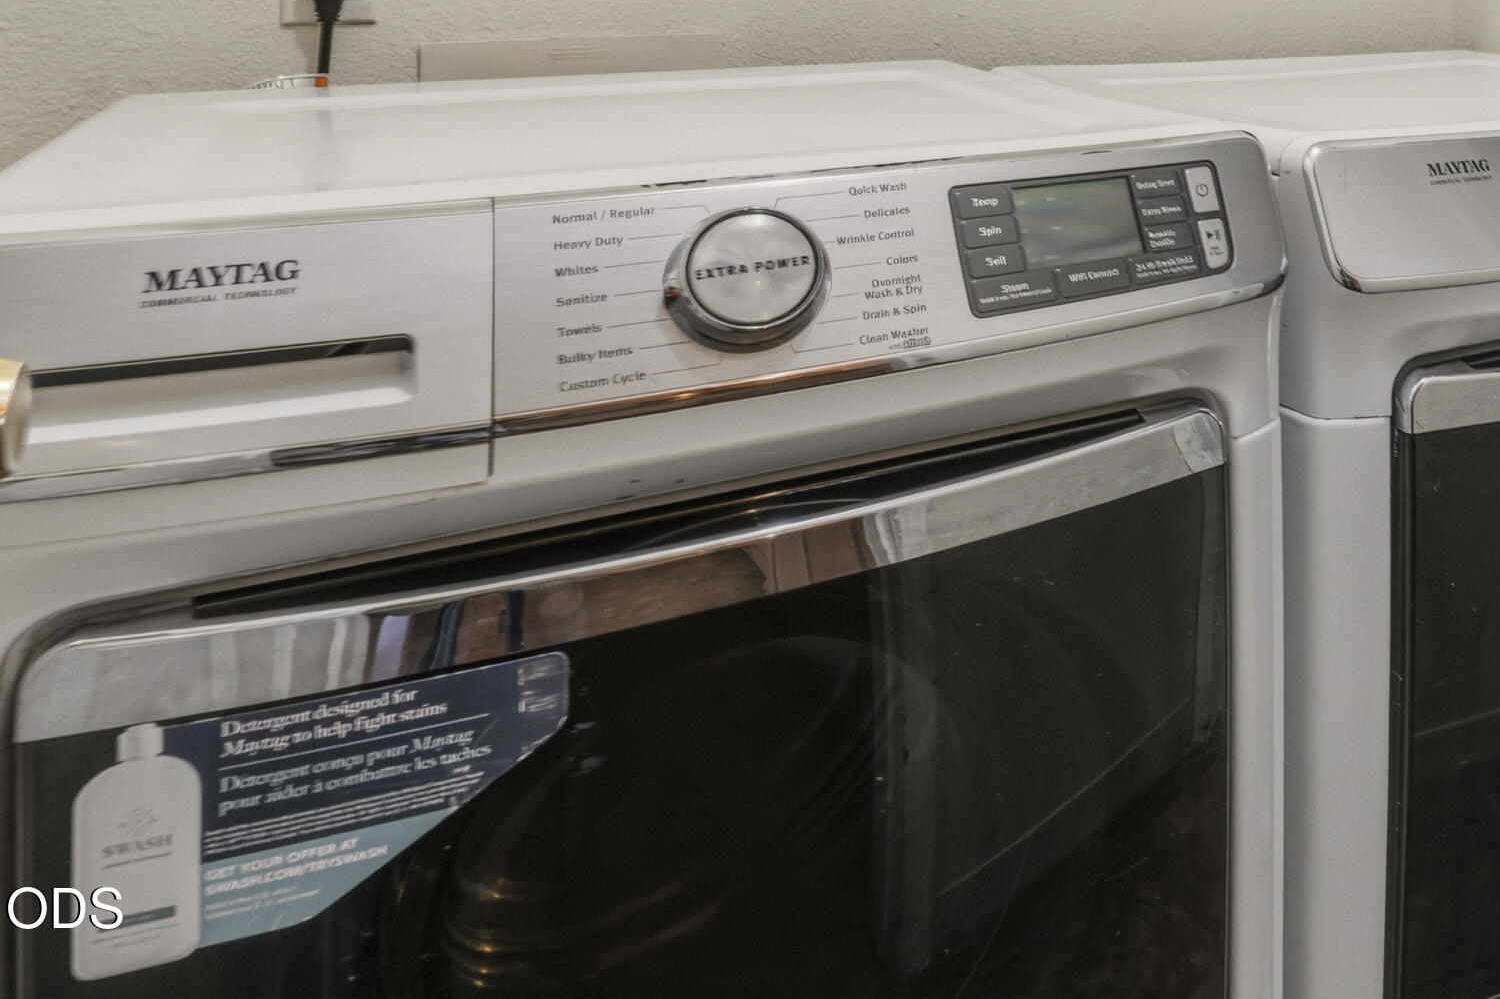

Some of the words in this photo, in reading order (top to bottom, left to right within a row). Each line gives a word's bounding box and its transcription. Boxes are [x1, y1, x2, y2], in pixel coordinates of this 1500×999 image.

[1426, 158, 1490, 177] MAYTAG
[848, 185, 879, 196] Quick
[880, 182, 907, 193] Wash
[552, 211, 597, 224] Normal
[610, 206, 656, 219] Regular
[863, 207, 911, 219] Delicates
[554, 240, 592, 251] Heavy
[595, 236, 623, 247] Duty
[836, 233, 876, 246] Wrinkle
[878, 228, 915, 241] Control
[695, 264, 748, 280] EXTRA
[754, 256, 810, 272] POWER
[886, 255, 918, 266] Colors
[141, 260, 300, 293] MAYTAG
[555, 265, 599, 277] Whites
[871, 274, 921, 288] Overnight
[556, 292, 608, 307] Sanitize
[864, 289, 893, 300] Wash
[905, 285, 923, 295] Dry
[862, 309, 890, 320] Drain
[903, 303, 927, 314] Spin
[557, 323, 602, 337] Towels
[859, 333, 889, 345] Clean
[891, 327, 929, 340] Washer
[558, 352, 595, 365] Bulky
[598, 347, 633, 360] Items
[560, 378, 608, 392] Custom
[613, 371, 646, 385] Cycle
[220, 710, 314, 739] Detergent
[312, 692, 390, 720] designed
[391, 689, 419, 704] for
[220, 735, 291, 758] Maytag
[292, 729, 312, 744] to
[314, 720, 352, 739] help
[353, 711, 397, 733] fight
[399, 703, 448, 720] stains
[366, 743, 408, 766] pour
[409, 729, 475, 755] Maytag
[218, 794, 263, 818] pour
[264, 784, 310, 804] aider
[414, 756, 438, 771] les
[103, 833, 172, 859] SWASH
[206, 864, 236, 881] GET
[241, 855, 284, 873] YOUR
[286, 842, 336, 863] OFFER
[338, 836, 360, 850] AT
